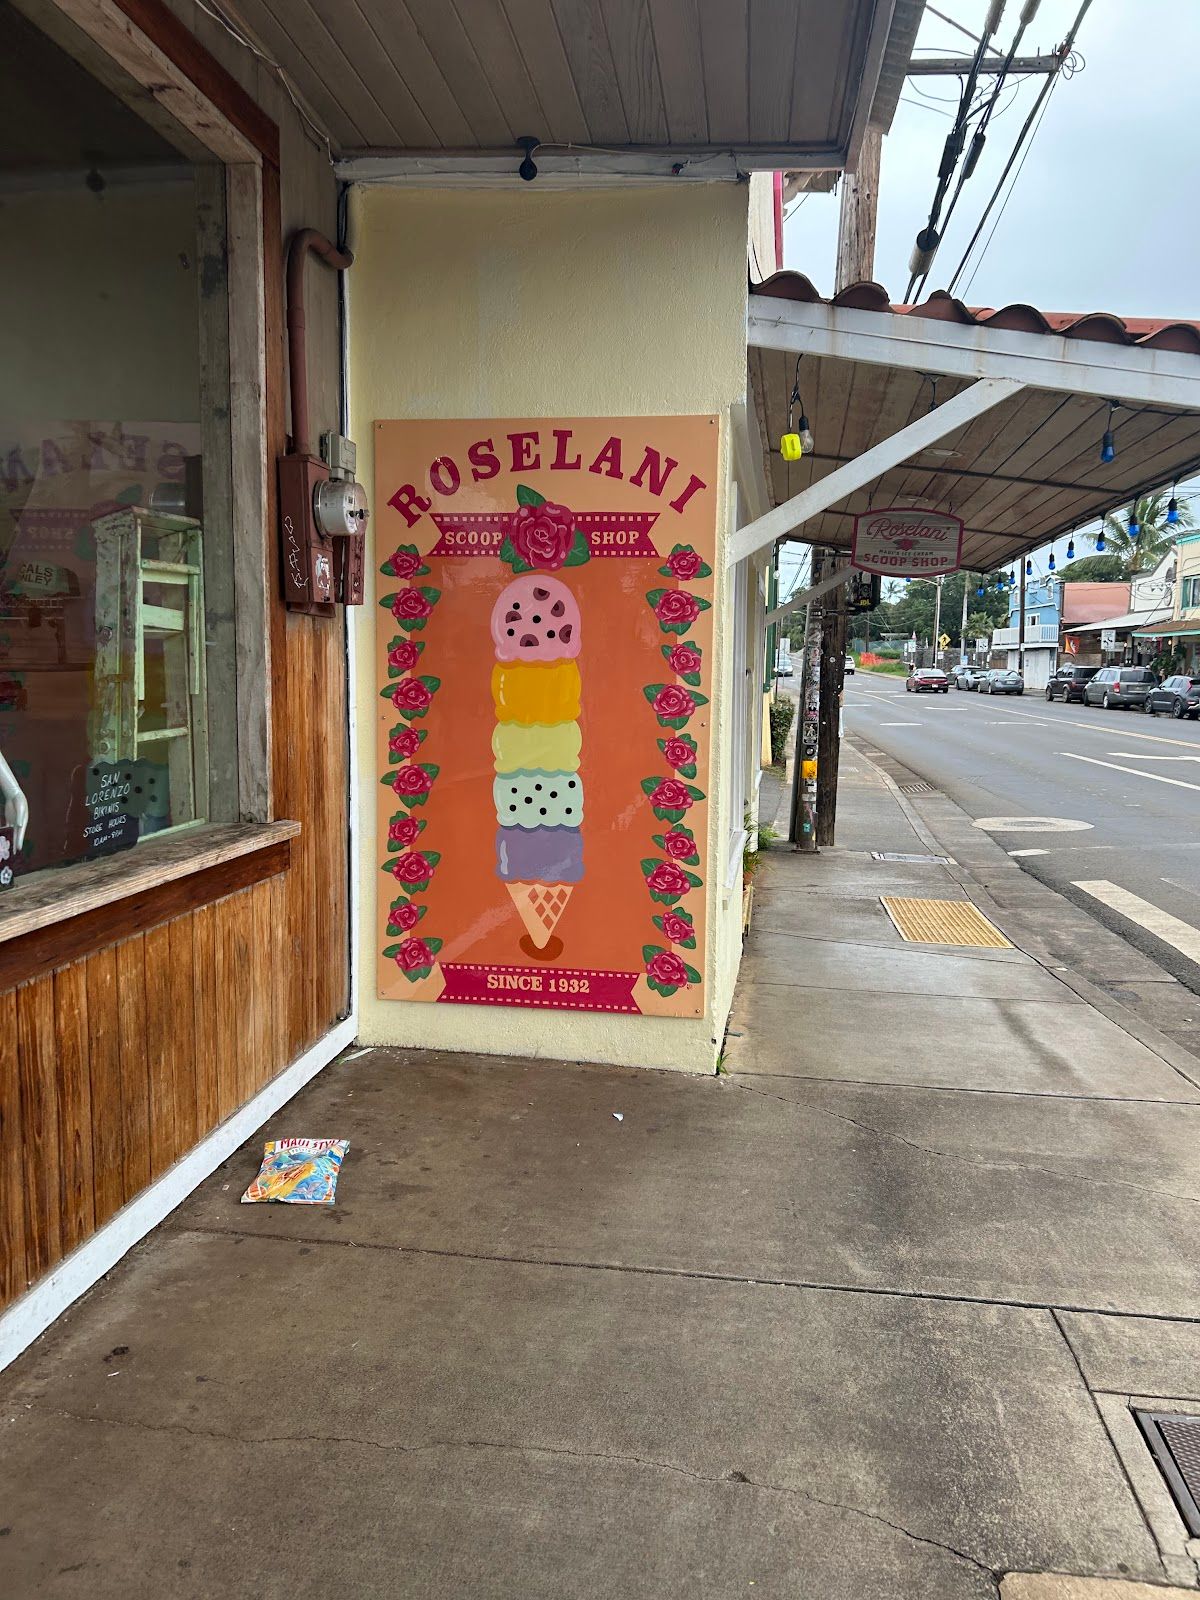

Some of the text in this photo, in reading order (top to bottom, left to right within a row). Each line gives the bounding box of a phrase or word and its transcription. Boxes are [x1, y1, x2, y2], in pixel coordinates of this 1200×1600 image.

[386, 429, 707, 528] ROSELANI
[866, 517, 951, 541] Roselani
[444, 530, 640, 545] SCOOP SHOP
[863, 553, 949, 567] SCOOP SHOP
[19, 563, 54, 578] CALS
[100, 771, 120, 788] SAN
[85, 783, 130, 806] LORENZO
[83, 822, 103, 838] STORE
[487, 974, 590, 994] SINCE 1932
[280, 1138, 310, 1149] MAUI
